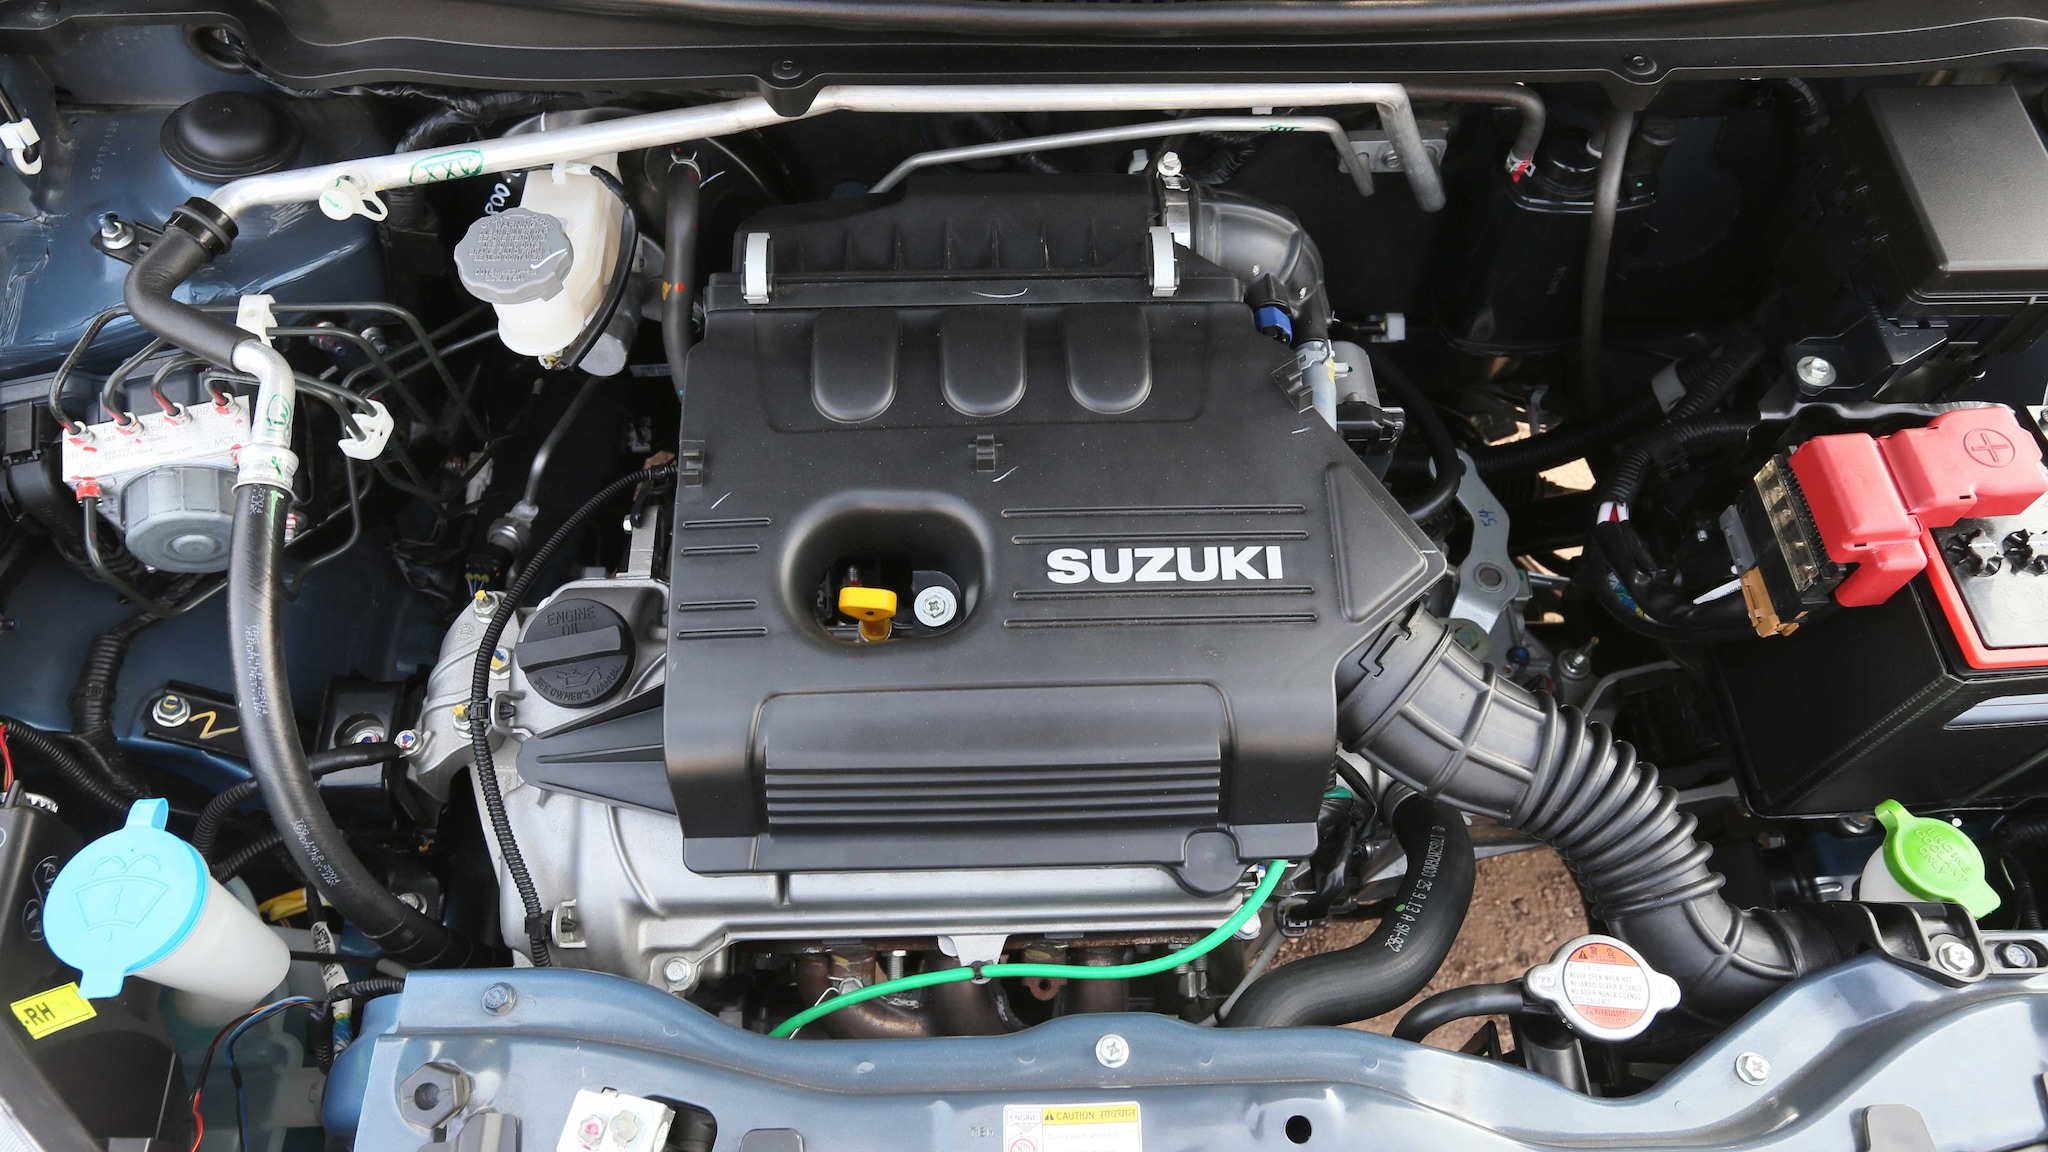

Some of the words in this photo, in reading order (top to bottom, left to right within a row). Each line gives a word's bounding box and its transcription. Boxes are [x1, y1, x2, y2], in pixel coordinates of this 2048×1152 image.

[495, 221, 536, 229] WARNING
[1046, 546, 1283, 584] SUZUKI
[547, 606, 596, 625] ENGINE
[535, 676, 551, 693] SEE
[550, 689, 590, 701] OWNER'S
[592, 664, 623, 697] MANUAL
[1914, 829, 1968, 882] COOLANT
[1917, 846, 1947, 874] ONLY
[1927, 828, 1972, 874] ENGINE
[1401, 913, 1416, 922] A
[1569, 972, 1586, 980] NEVER
[1056, 1111, 1095, 1121] CAUTION
[1099, 1108, 1136, 1119] सावधान
